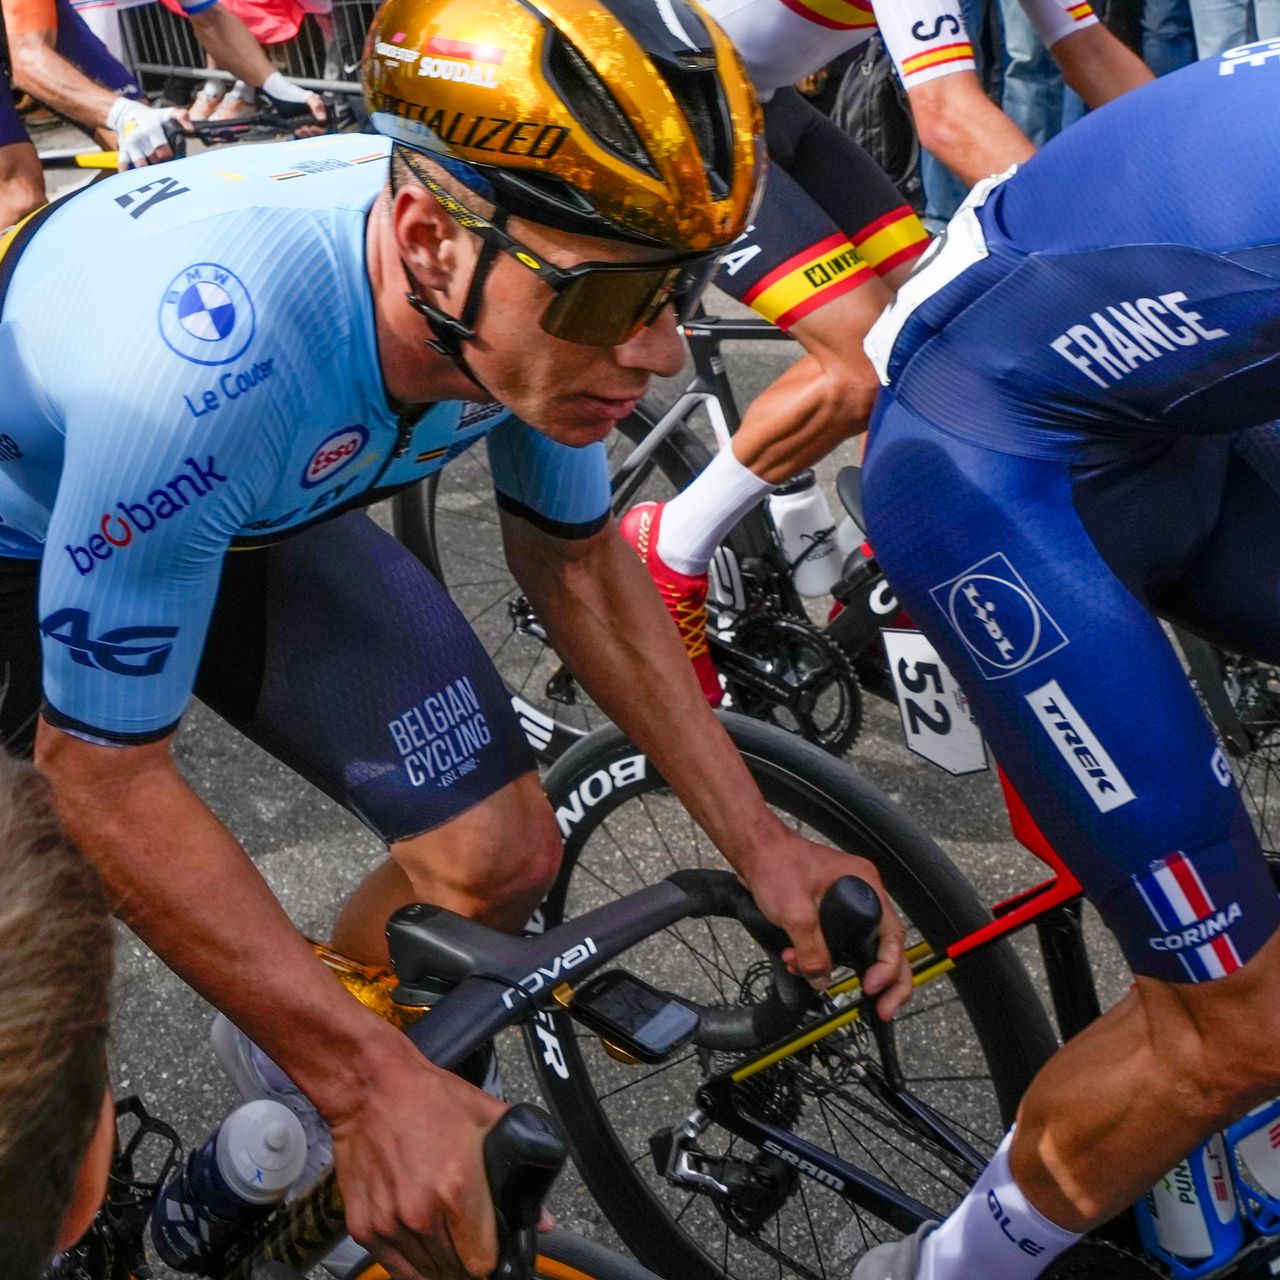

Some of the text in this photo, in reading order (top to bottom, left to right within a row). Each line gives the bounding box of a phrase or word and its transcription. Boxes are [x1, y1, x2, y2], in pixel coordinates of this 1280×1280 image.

[417, 56, 500, 89] SOUDAL
[1049, 290, 1230, 390] FRANCE
[183, 357, 275, 418] Le Couter
[310, 438, 359, 477] Esso
[388, 676, 481, 756] BELGIAN
[898, 657, 952, 736] 52
[404, 712, 493, 787] CYCLING
[1043, 696, 1118, 795] TREK
[1149, 901, 1244, 951] CORIMA
[762, 1139, 846, 1192] SRAM
